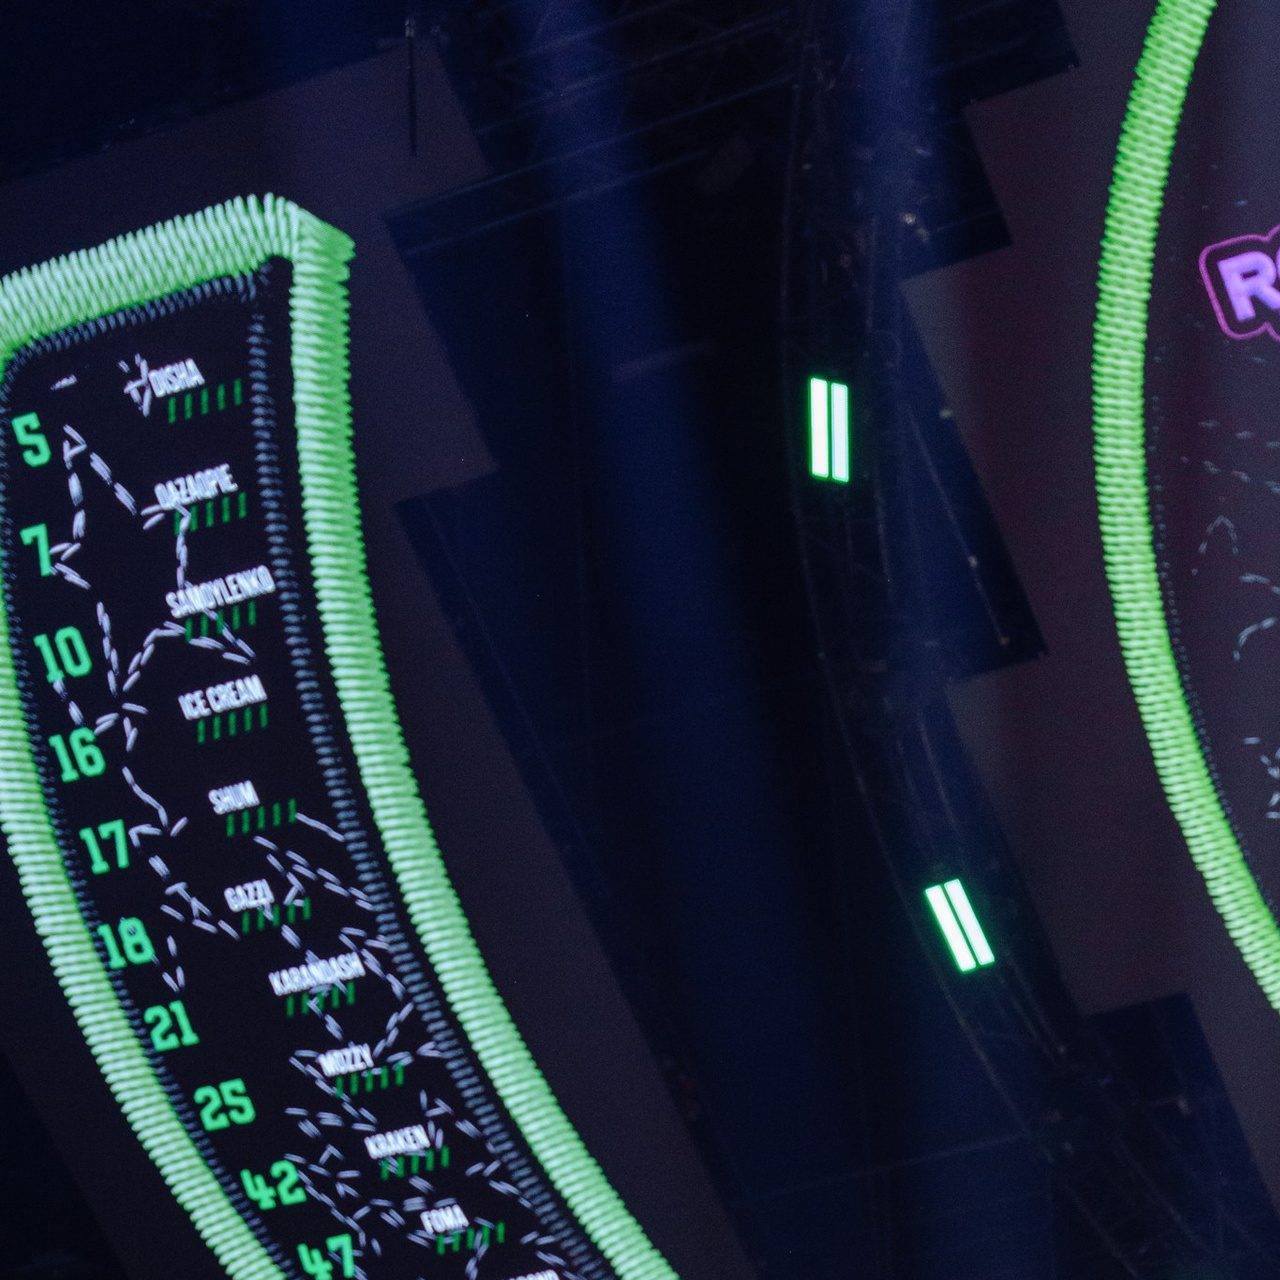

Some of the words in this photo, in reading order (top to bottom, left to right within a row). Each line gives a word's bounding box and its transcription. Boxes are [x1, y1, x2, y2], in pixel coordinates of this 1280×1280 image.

[12, 412, 51, 467] 5
[20, 523, 52, 577] 7
[34, 626, 92, 683] 10
[178, 689, 212, 720] ICE
[205, 674, 267, 713] CREAM
[49, 726, 106, 782] 16
[80, 819, 129, 874] 17
[97, 917, 154, 969] 18
[268, 951, 366, 996] KARANDASH
[144, 1000, 199, 1052] 21
[318, 1043, 374, 1077] MOZZY
[194, 1078, 256, 1131] 25
[364, 1124, 431, 1159] KRAKEN
[240, 1160, 307, 1210] 42
[420, 1204, 469, 1234] FOMA
